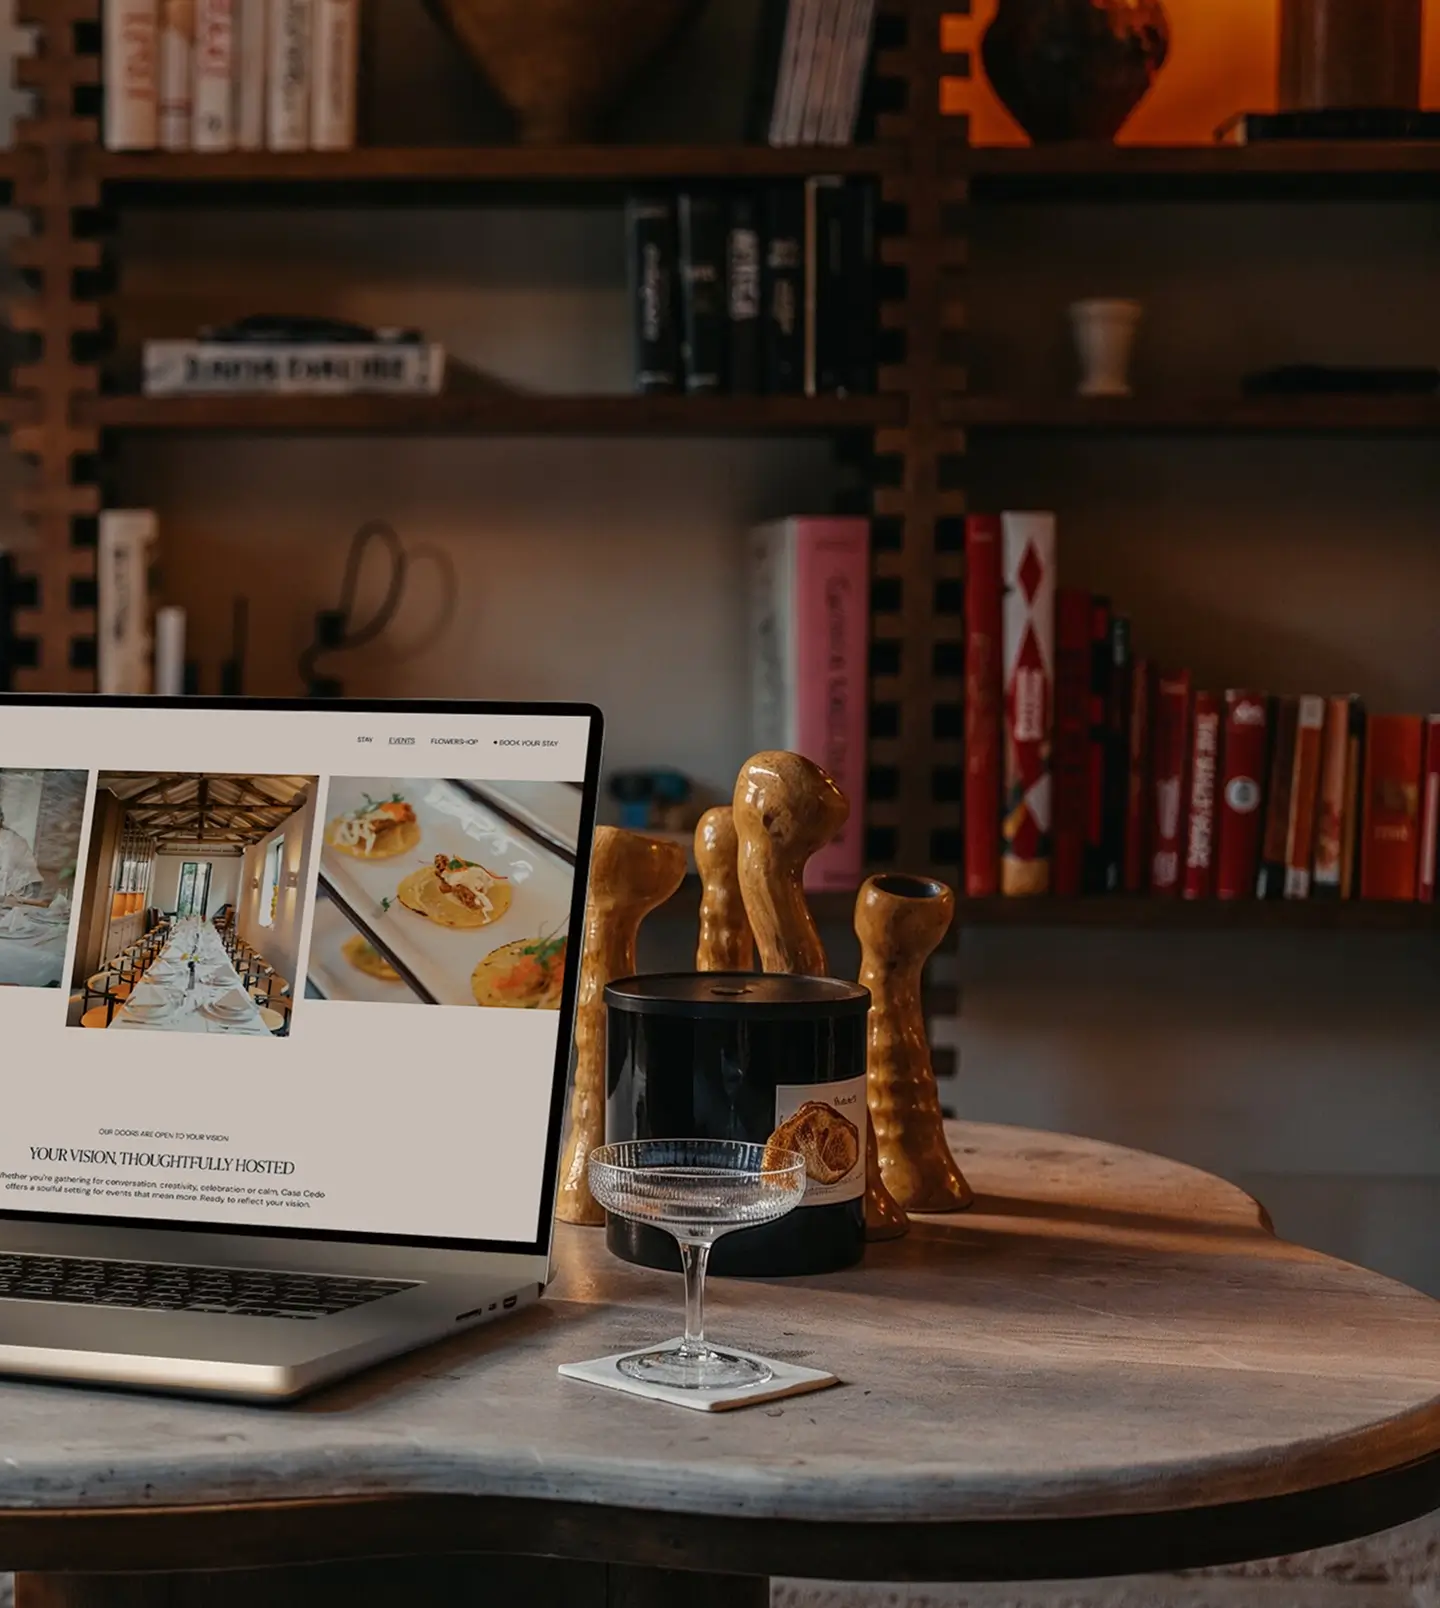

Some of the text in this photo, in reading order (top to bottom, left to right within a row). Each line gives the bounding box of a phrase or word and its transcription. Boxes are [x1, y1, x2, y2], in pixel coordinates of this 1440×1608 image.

[155, 1131, 173, 1139] OPEN
[206, 1134, 229, 1142] VISION
[29, 1147, 295, 1175] YOUR VISION, THOUGHTFULLY HOSTED
[5, 1183, 28, 1191] offers
[37, 1185, 62, 1193] soulful
[64, 1187, 91, 1196] setting
[200, 1196, 224, 1204] Ready
[29, 1174, 53, 1182] you're
[54, 1176, 91, 1185] gathering
[200, 1185, 245, 1193] celebration
[281, 1189, 301, 1197] Casa
[303, 1190, 325, 1198] Cedo
